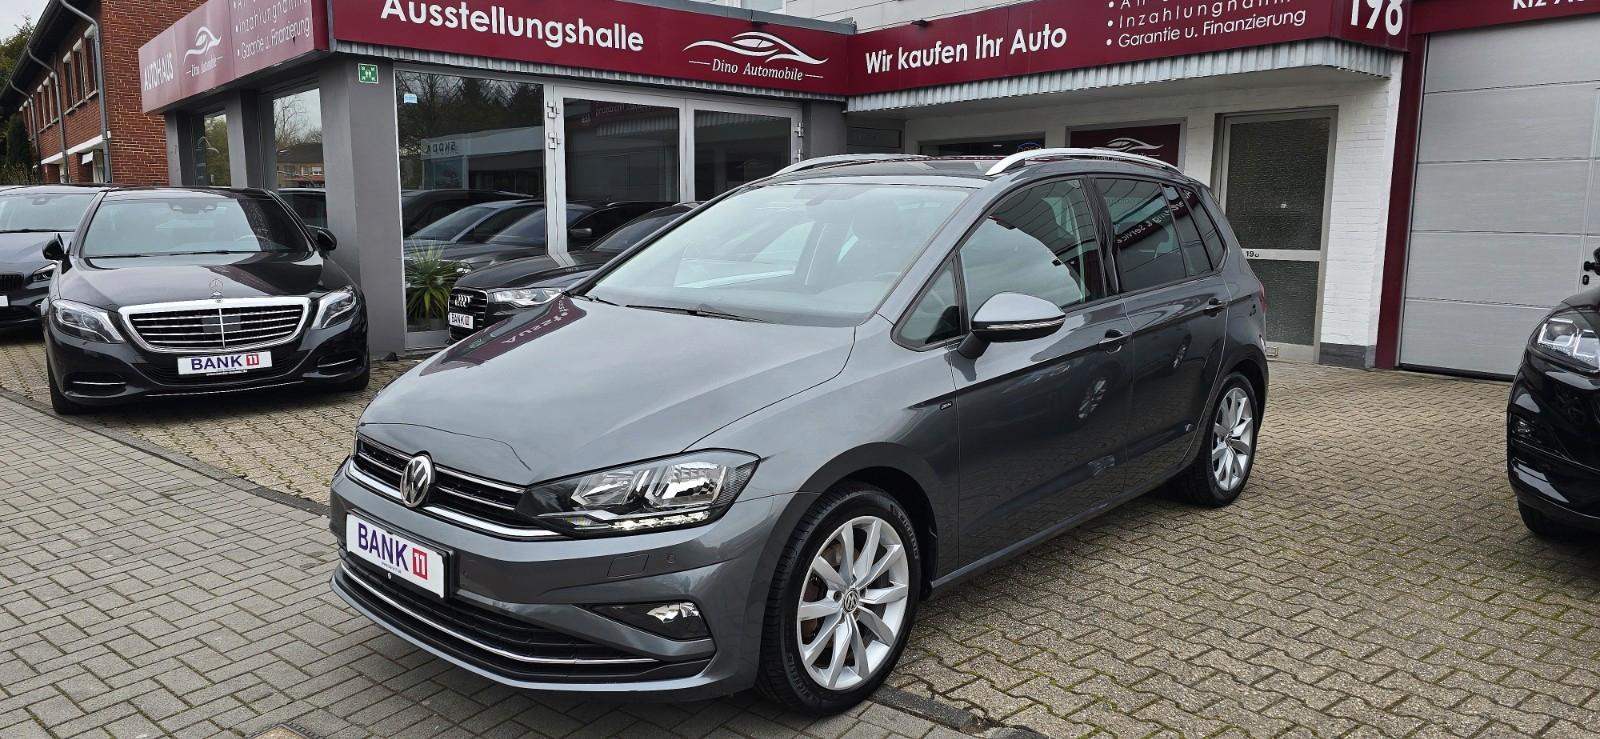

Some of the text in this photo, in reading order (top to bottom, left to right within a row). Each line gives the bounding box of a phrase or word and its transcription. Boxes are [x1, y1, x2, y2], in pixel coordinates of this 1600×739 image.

[380, 0, 644, 52] Ausstellungshalle
[1118, 9, 1307, 48] Garantie u. Finanzierung
[711, 57, 804, 82] Dino Automobile
[866, 24, 1067, 74] Wir kaufen Ihr Auto
[191, 355, 259, 371] BANK 11
[358, 522, 427, 579] BANK 11
